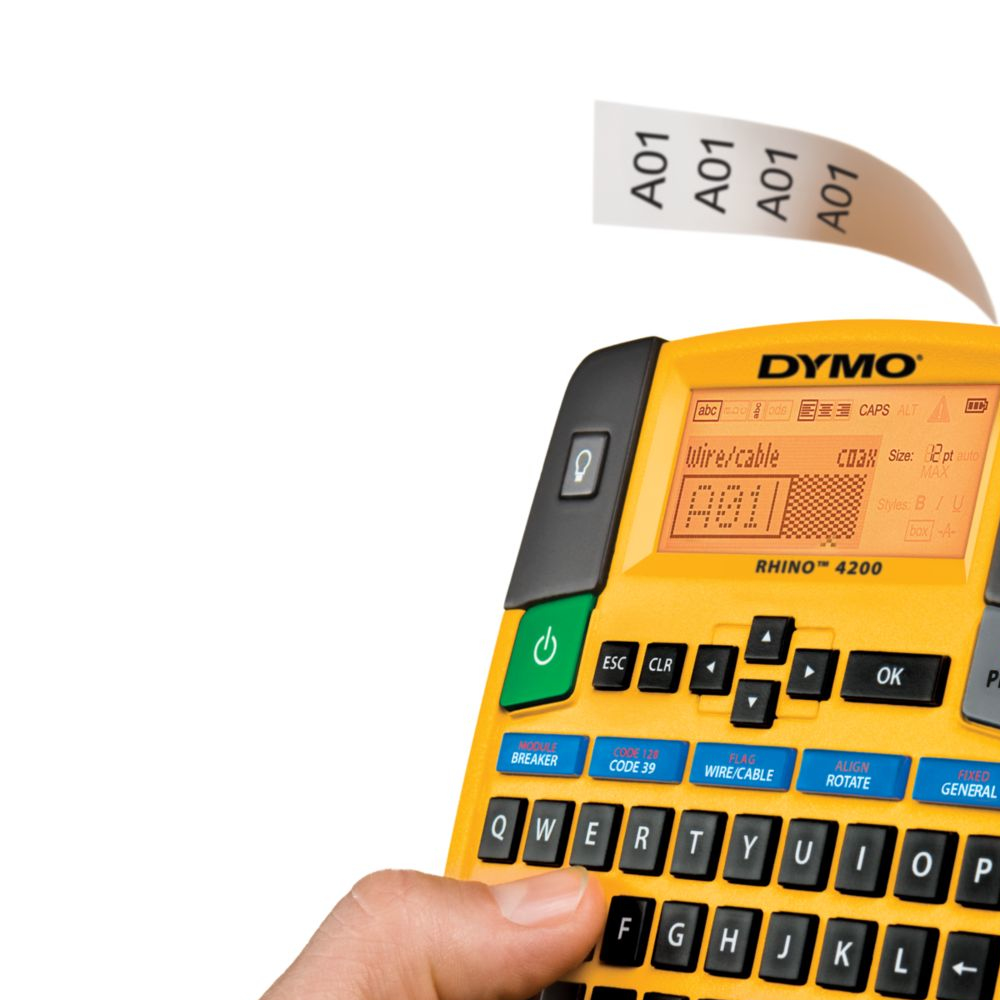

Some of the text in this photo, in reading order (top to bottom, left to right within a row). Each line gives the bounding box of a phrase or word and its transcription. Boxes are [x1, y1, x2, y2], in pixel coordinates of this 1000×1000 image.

[630, 131, 669, 209] A01
[694, 138, 734, 214] A01
[756, 148, 798, 221] A01
[816, 164, 859, 234] A01
[698, 403, 718, 416] abc
[753, 402, 762, 419] abc
[859, 403, 890, 416] CAPS
[896, 404, 919, 416] ALT
[686, 442, 780, 468] Wire/cable
[837, 449, 877, 468] coax
[888, 449, 914, 462] Size:
[921, 465, 950, 479] MAX
[914, 495, 926, 510] B
[952, 495, 965, 512] U
[909, 526, 929, 537] box
[835, 561, 883, 576] 4200
[602, 655, 627, 671] ESC
[648, 657, 673, 672] CLR
[877, 666, 905, 686] OK
[518, 740, 558, 753] MODULE
[613, 747, 659, 760] CODE 128
[511, 752, 558, 767] BREAKER
[729, 753, 756, 764] FLAG
[609, 759, 656, 774] CODE 39
[704, 765, 775, 782] WIRE/CABLE
[835, 760, 870, 773] ALIGN
[825, 774, 871, 790] ROTATE
[958, 770, 990, 782] FIXED
[941, 782, 998, 800] GENERAL
[491, 814, 993, 884] Q W E R T Y U I O P
[617, 917, 908, 974] F G H J K L
